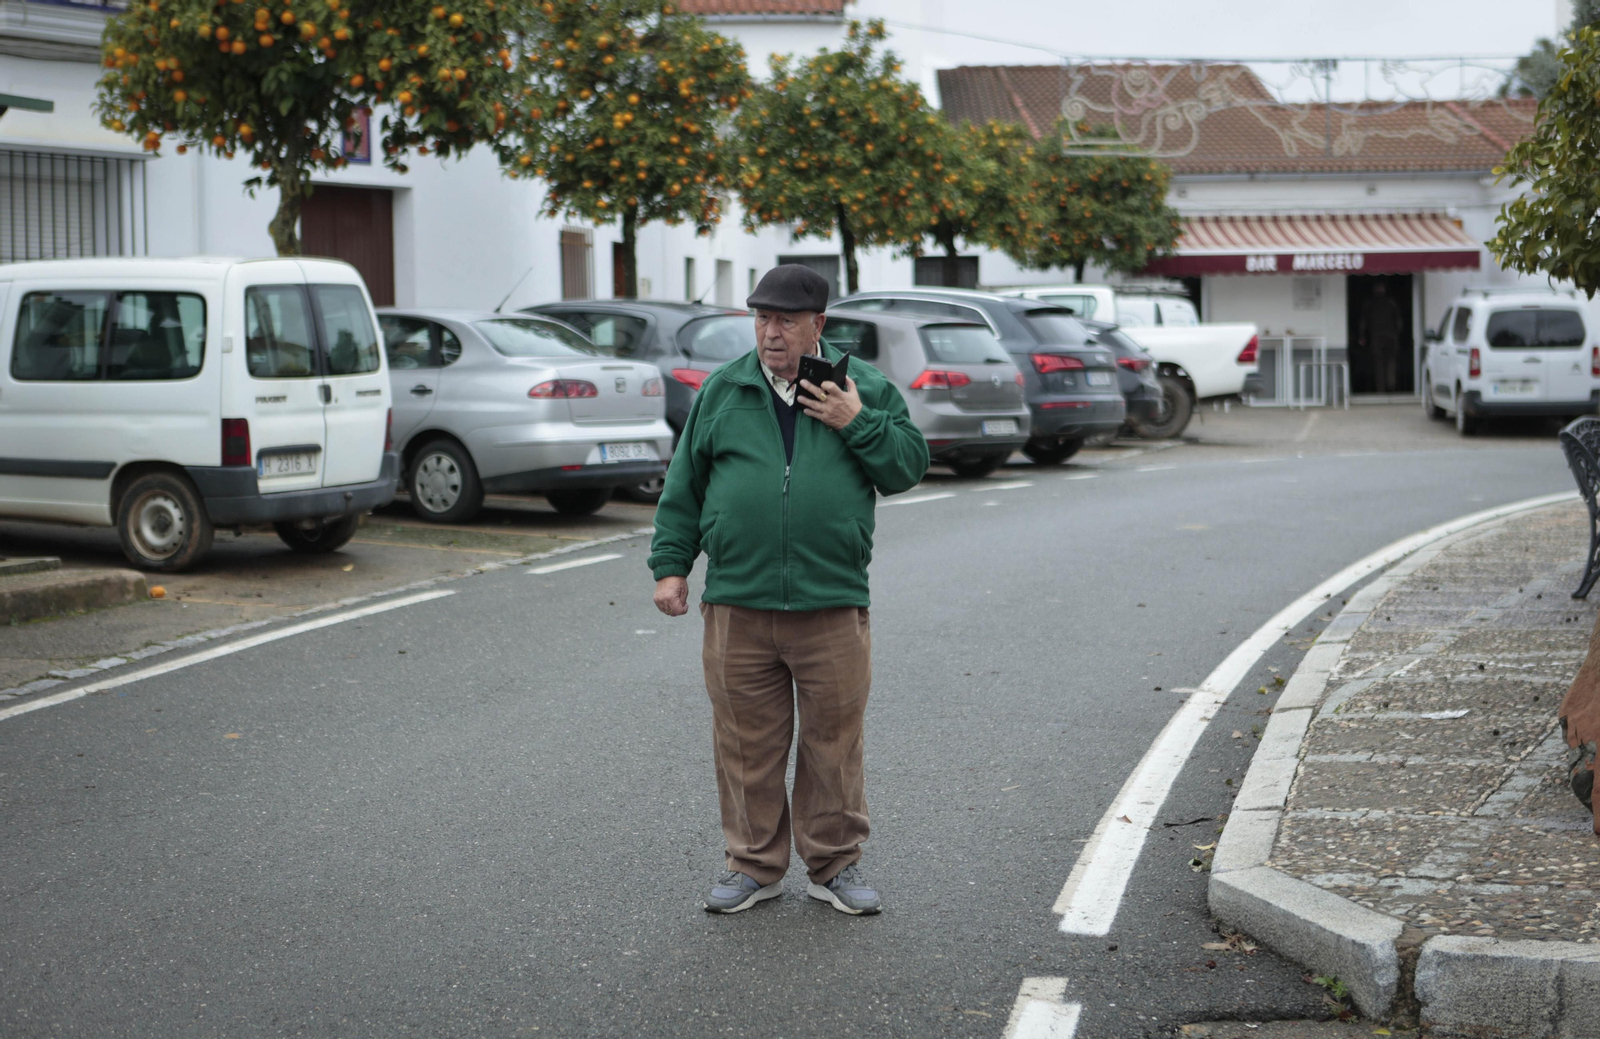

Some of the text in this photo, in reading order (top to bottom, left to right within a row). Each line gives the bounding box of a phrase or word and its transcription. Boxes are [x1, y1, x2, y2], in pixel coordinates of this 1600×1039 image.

[1245, 253, 1364, 272] BAR MARCELO
[264, 457, 272, 474] H
[278, 456, 301, 473] 2316
